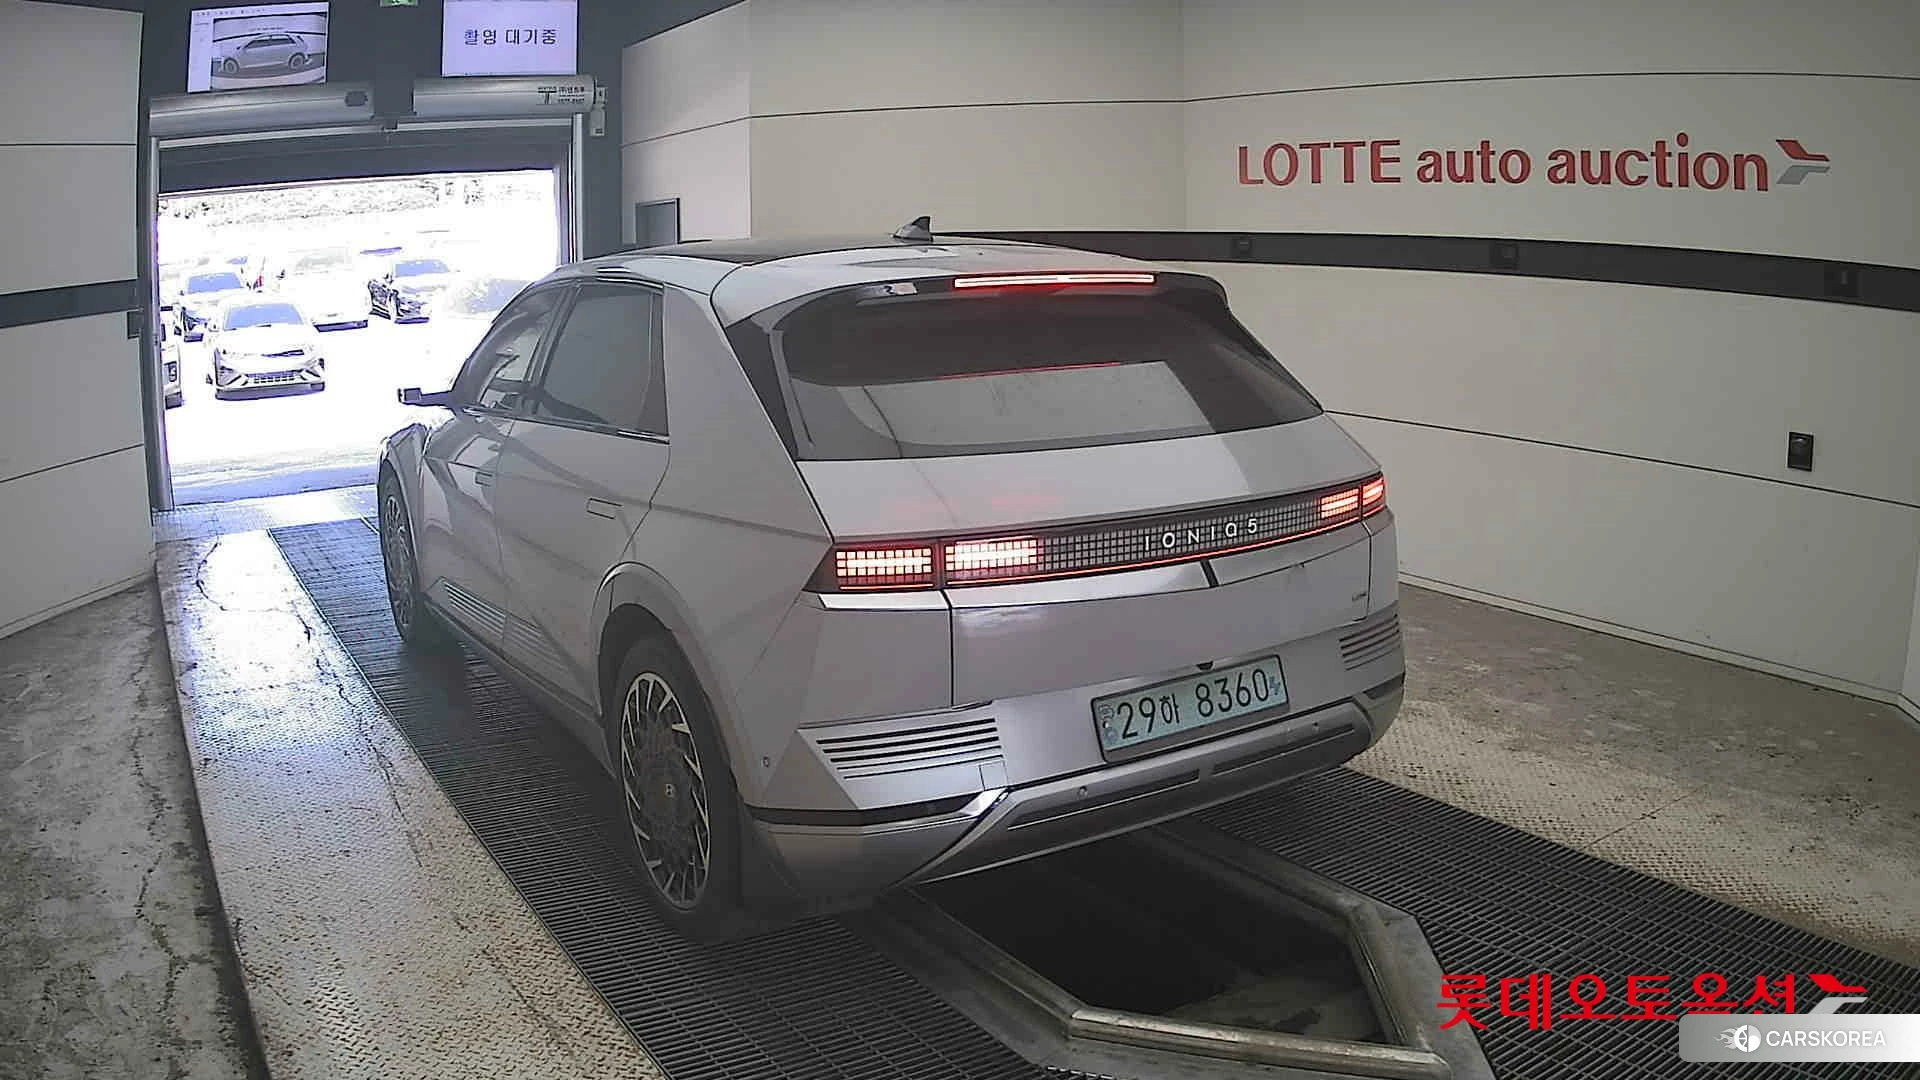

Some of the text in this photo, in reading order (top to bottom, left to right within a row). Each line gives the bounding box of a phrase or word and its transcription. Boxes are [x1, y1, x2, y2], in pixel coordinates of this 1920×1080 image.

[505, 29, 557, 45] 대기중
[1238, 132, 1769, 192] LOTTE auto auction
[1116, 668, 1269, 740] 29하 8360
